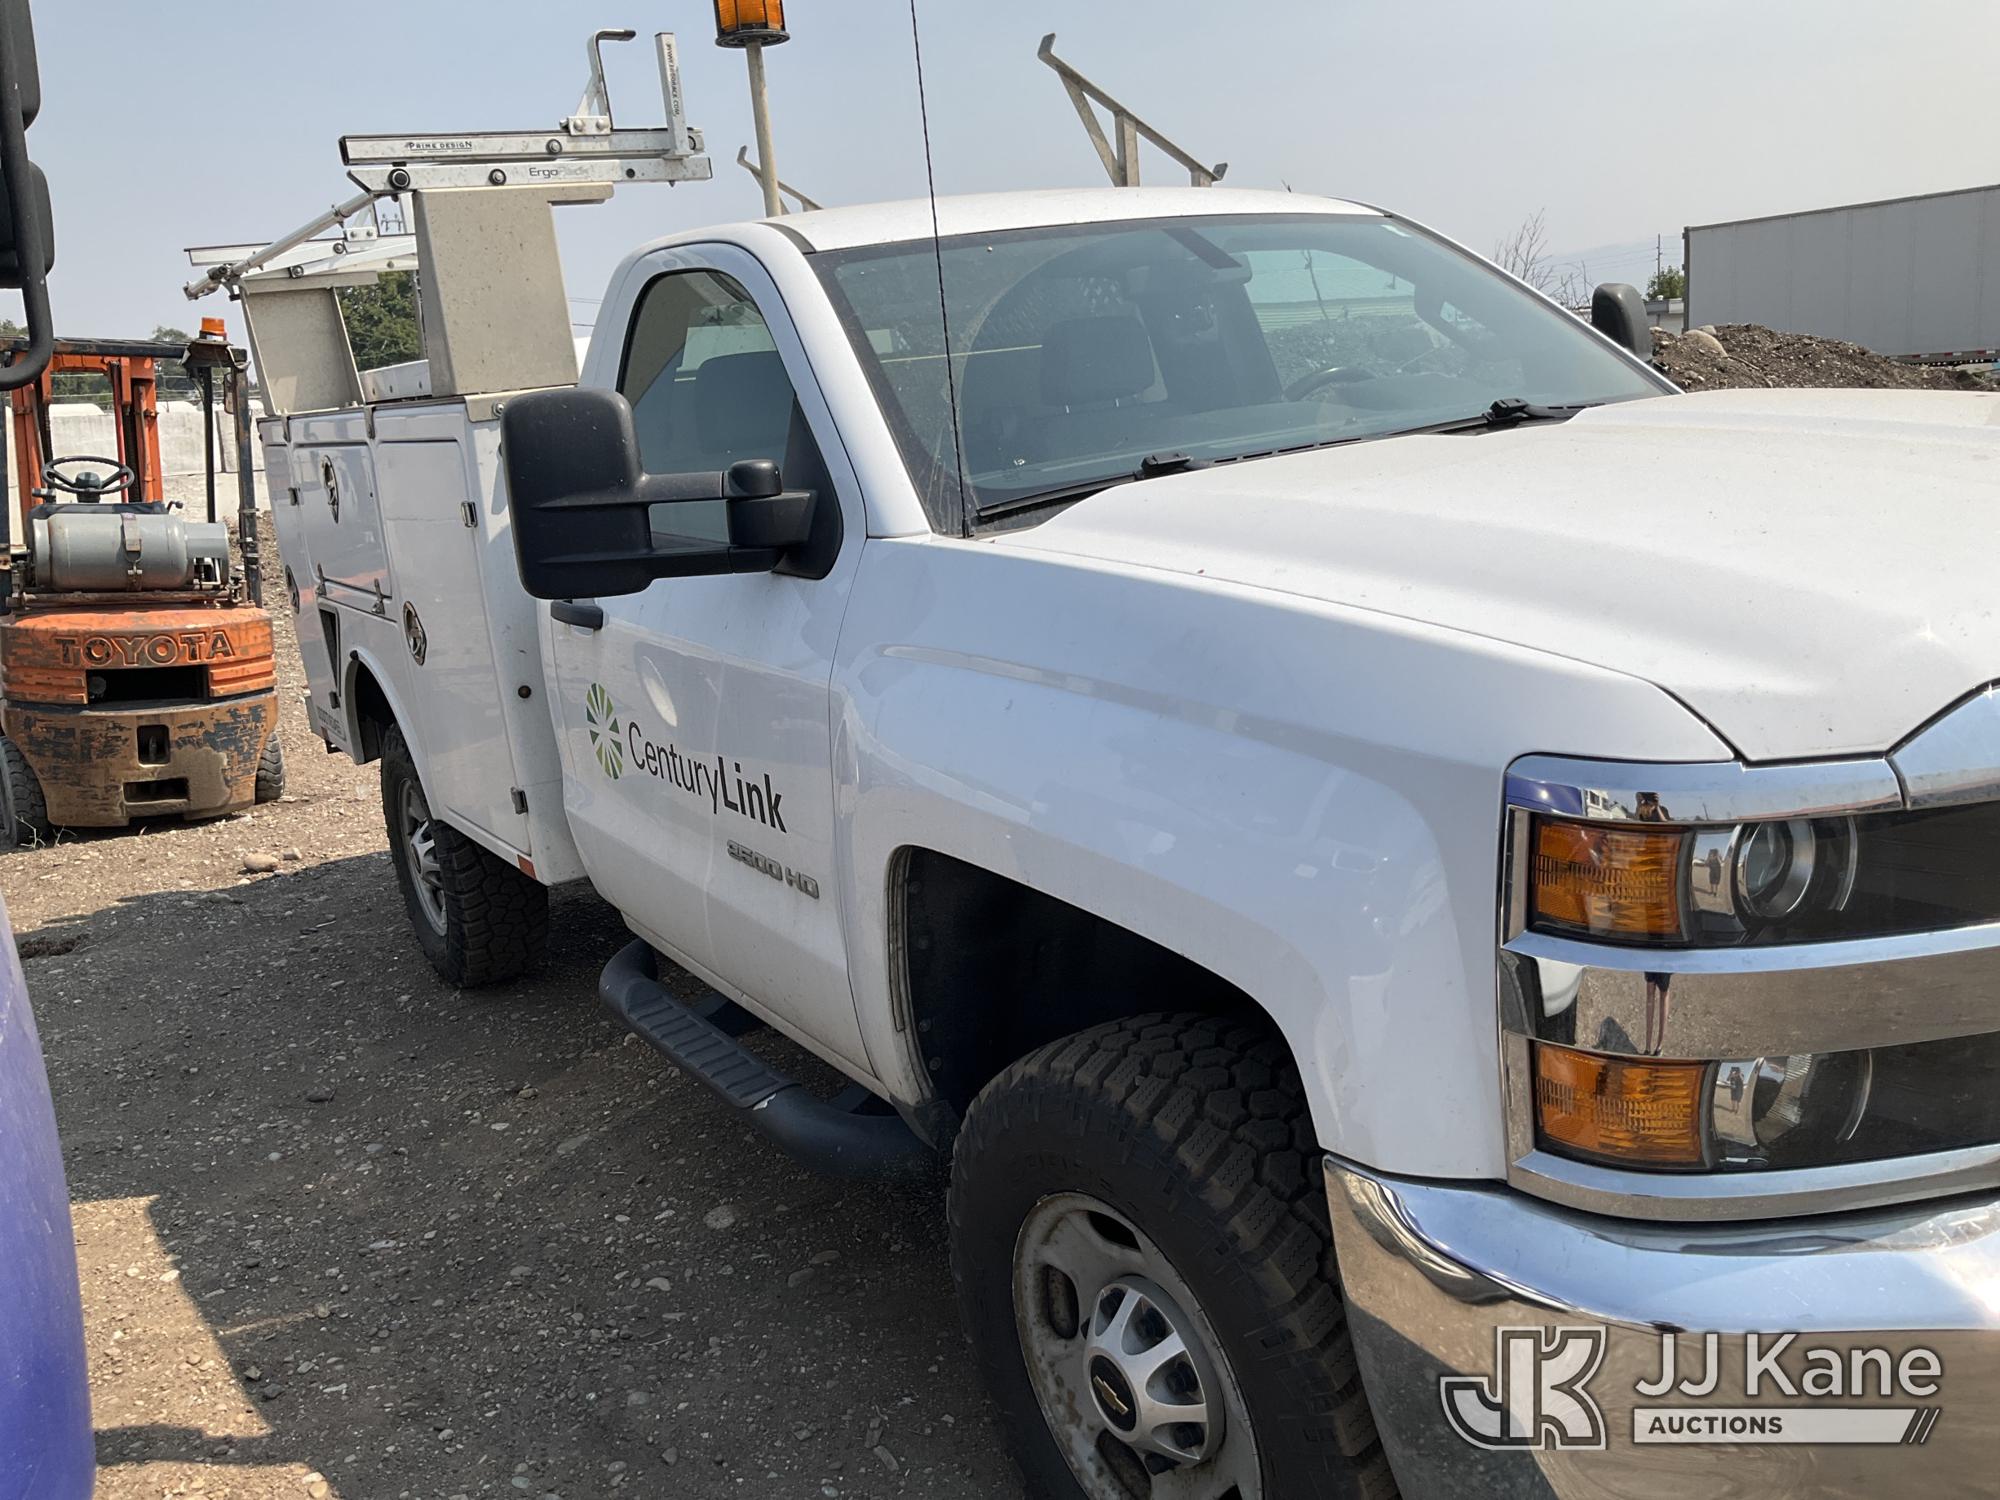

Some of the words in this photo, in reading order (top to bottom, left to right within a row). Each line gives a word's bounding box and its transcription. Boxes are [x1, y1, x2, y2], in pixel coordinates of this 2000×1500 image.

[53, 630, 235, 667] TOYOTA
[627, 721, 787, 833] CenturyLink
[785, 866, 820, 900] HD
